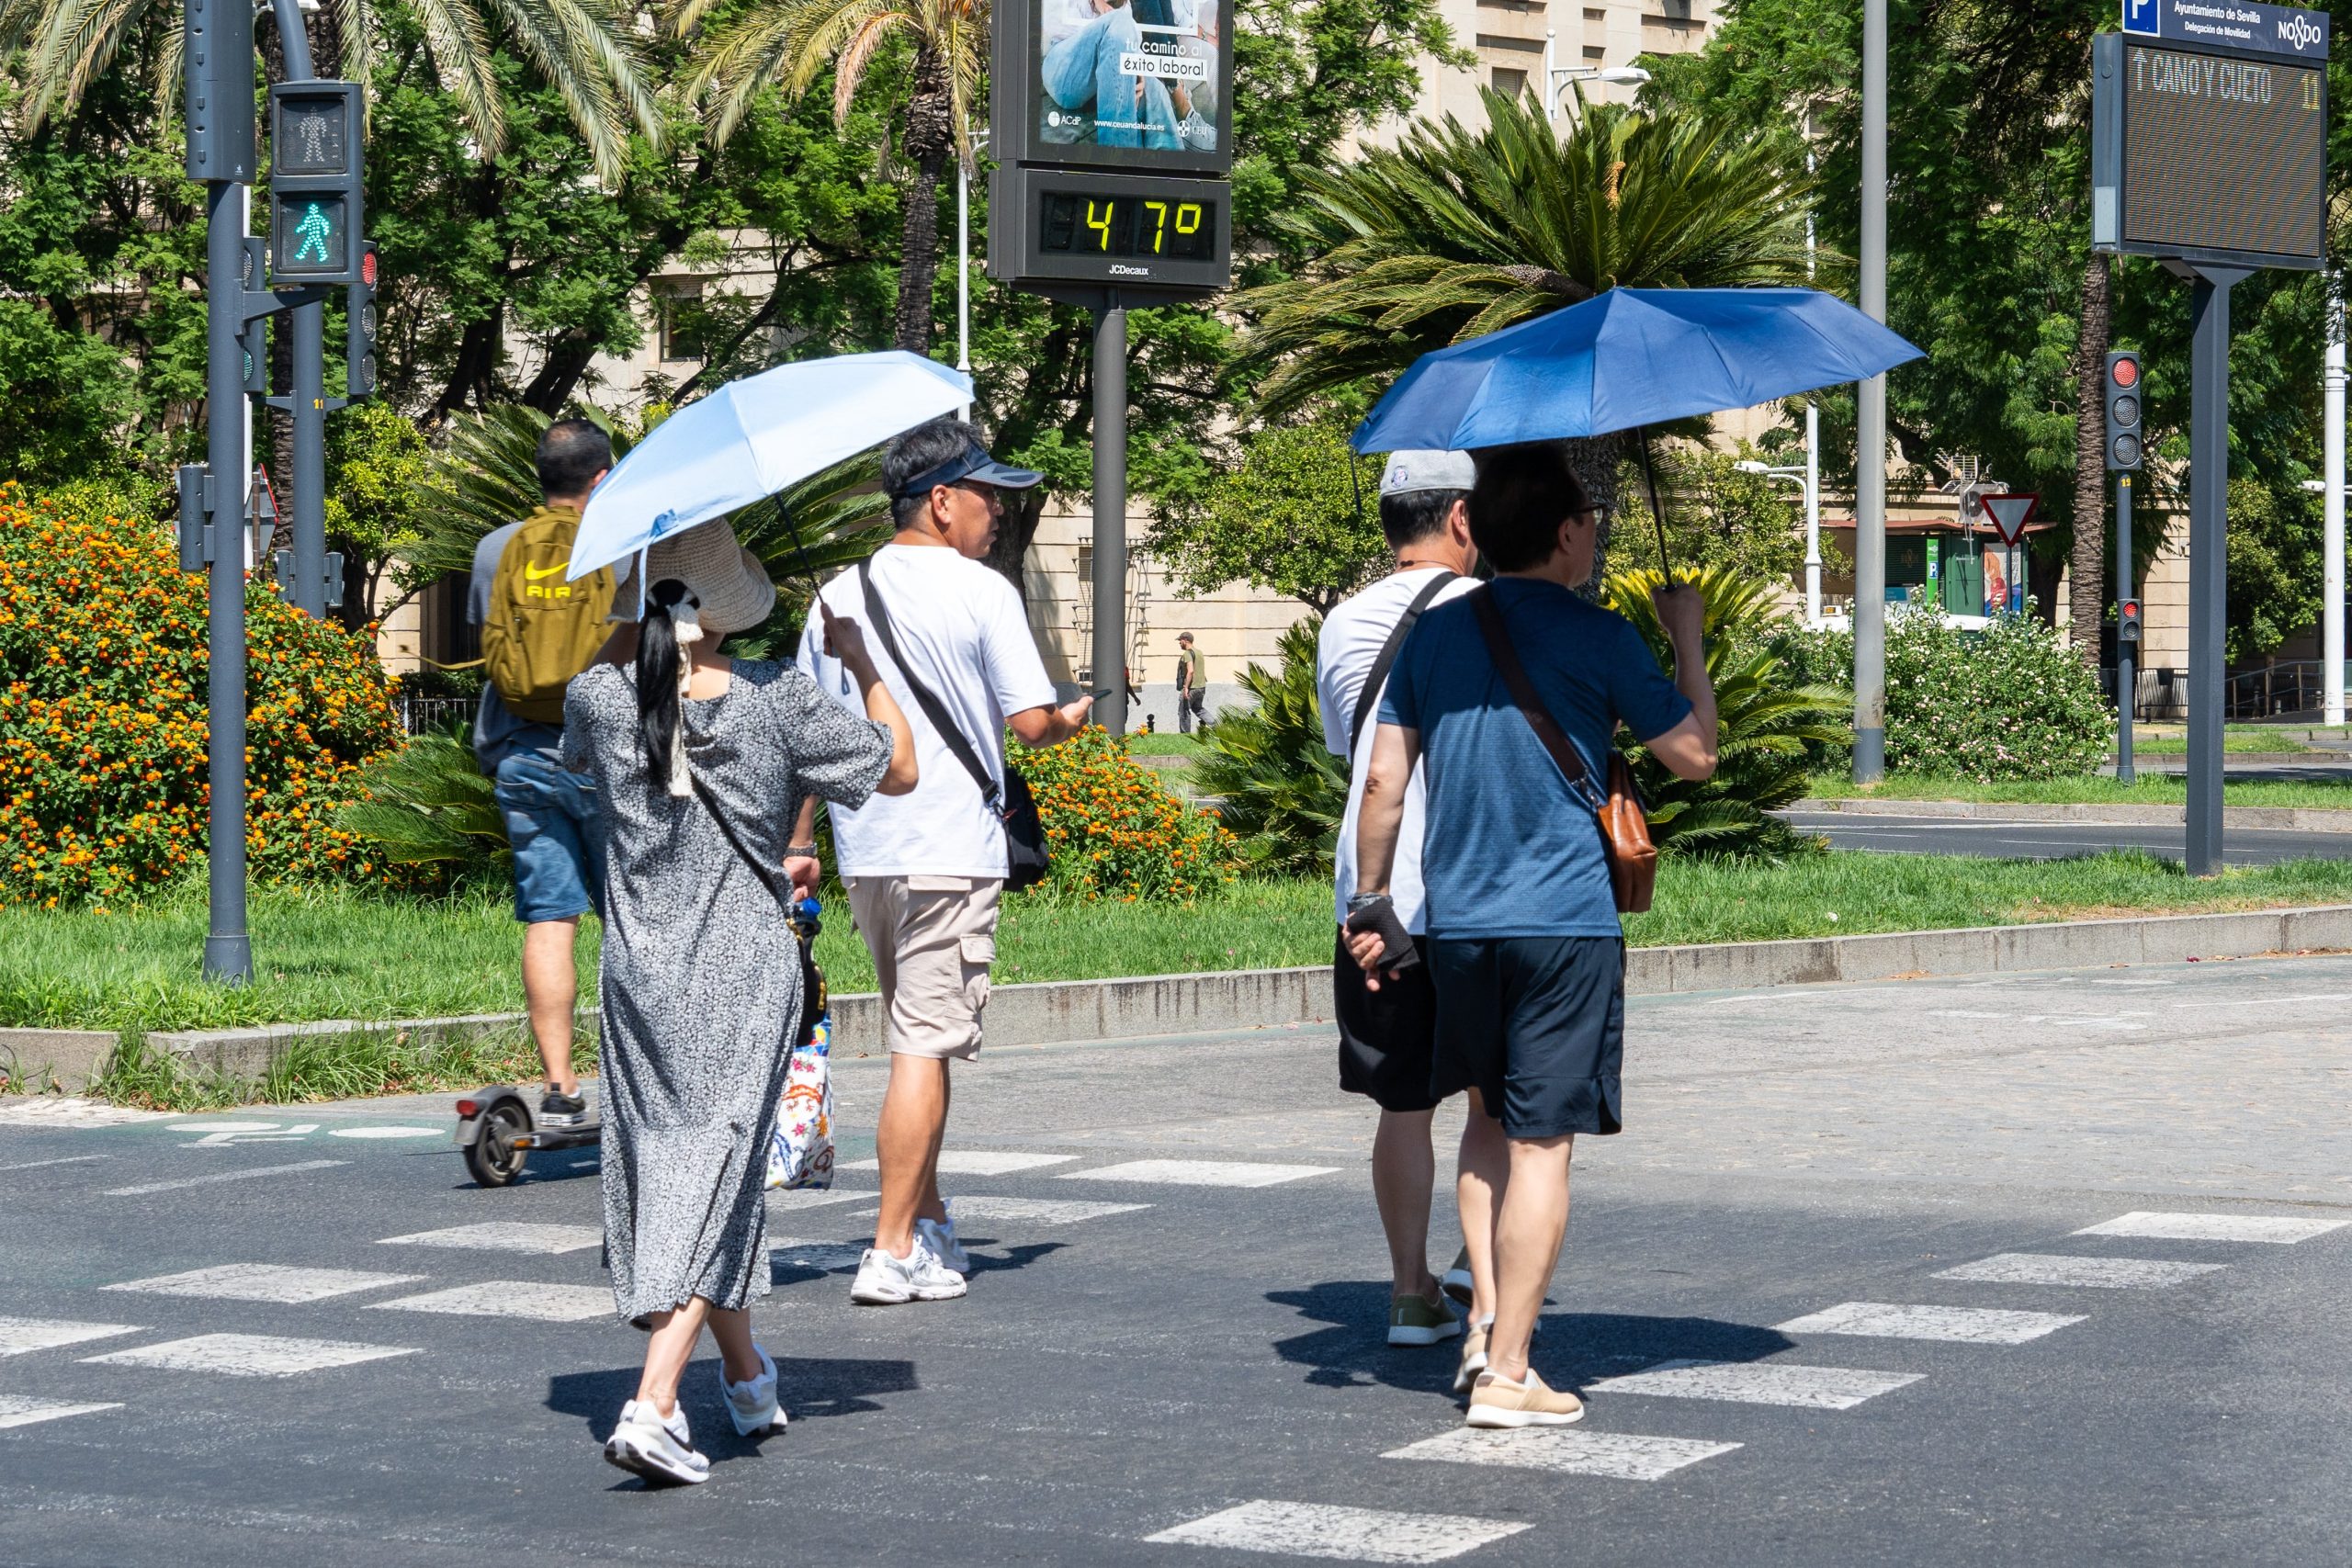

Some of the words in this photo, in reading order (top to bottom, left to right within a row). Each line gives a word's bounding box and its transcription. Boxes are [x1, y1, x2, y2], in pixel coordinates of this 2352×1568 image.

[2132, 0, 2149, 19] P
[2174, 0, 2224, 19] Ayuntamiento
[2225, 7, 2236, 21] de
[2236, 8, 2261, 24] Sevilla
[2184, 20, 2215, 35] Delegación
[2216, 25, 2224, 35] de
[2224, 26, 2251, 39] Movilidad
[1125, 38, 1137, 51] tu
[1141, 40, 1187, 55] camino
[1191, 43, 1203, 56] al
[1124, 57, 1155, 72] éxito
[1159, 58, 1204, 76] laboral
[2152, 54, 2199, 95] CANO
[2202, 59, 2215, 97] Y
[2220, 62, 2271, 104] CUETO
[2300, 73, 2321, 110] 11
[1093, 119, 1165, 131] www.ceuandalucia.es
[1109, 265, 1148, 276] JCDecaux
[313, 398, 323, 410] 11
[526, 585, 571, 599] AIR
